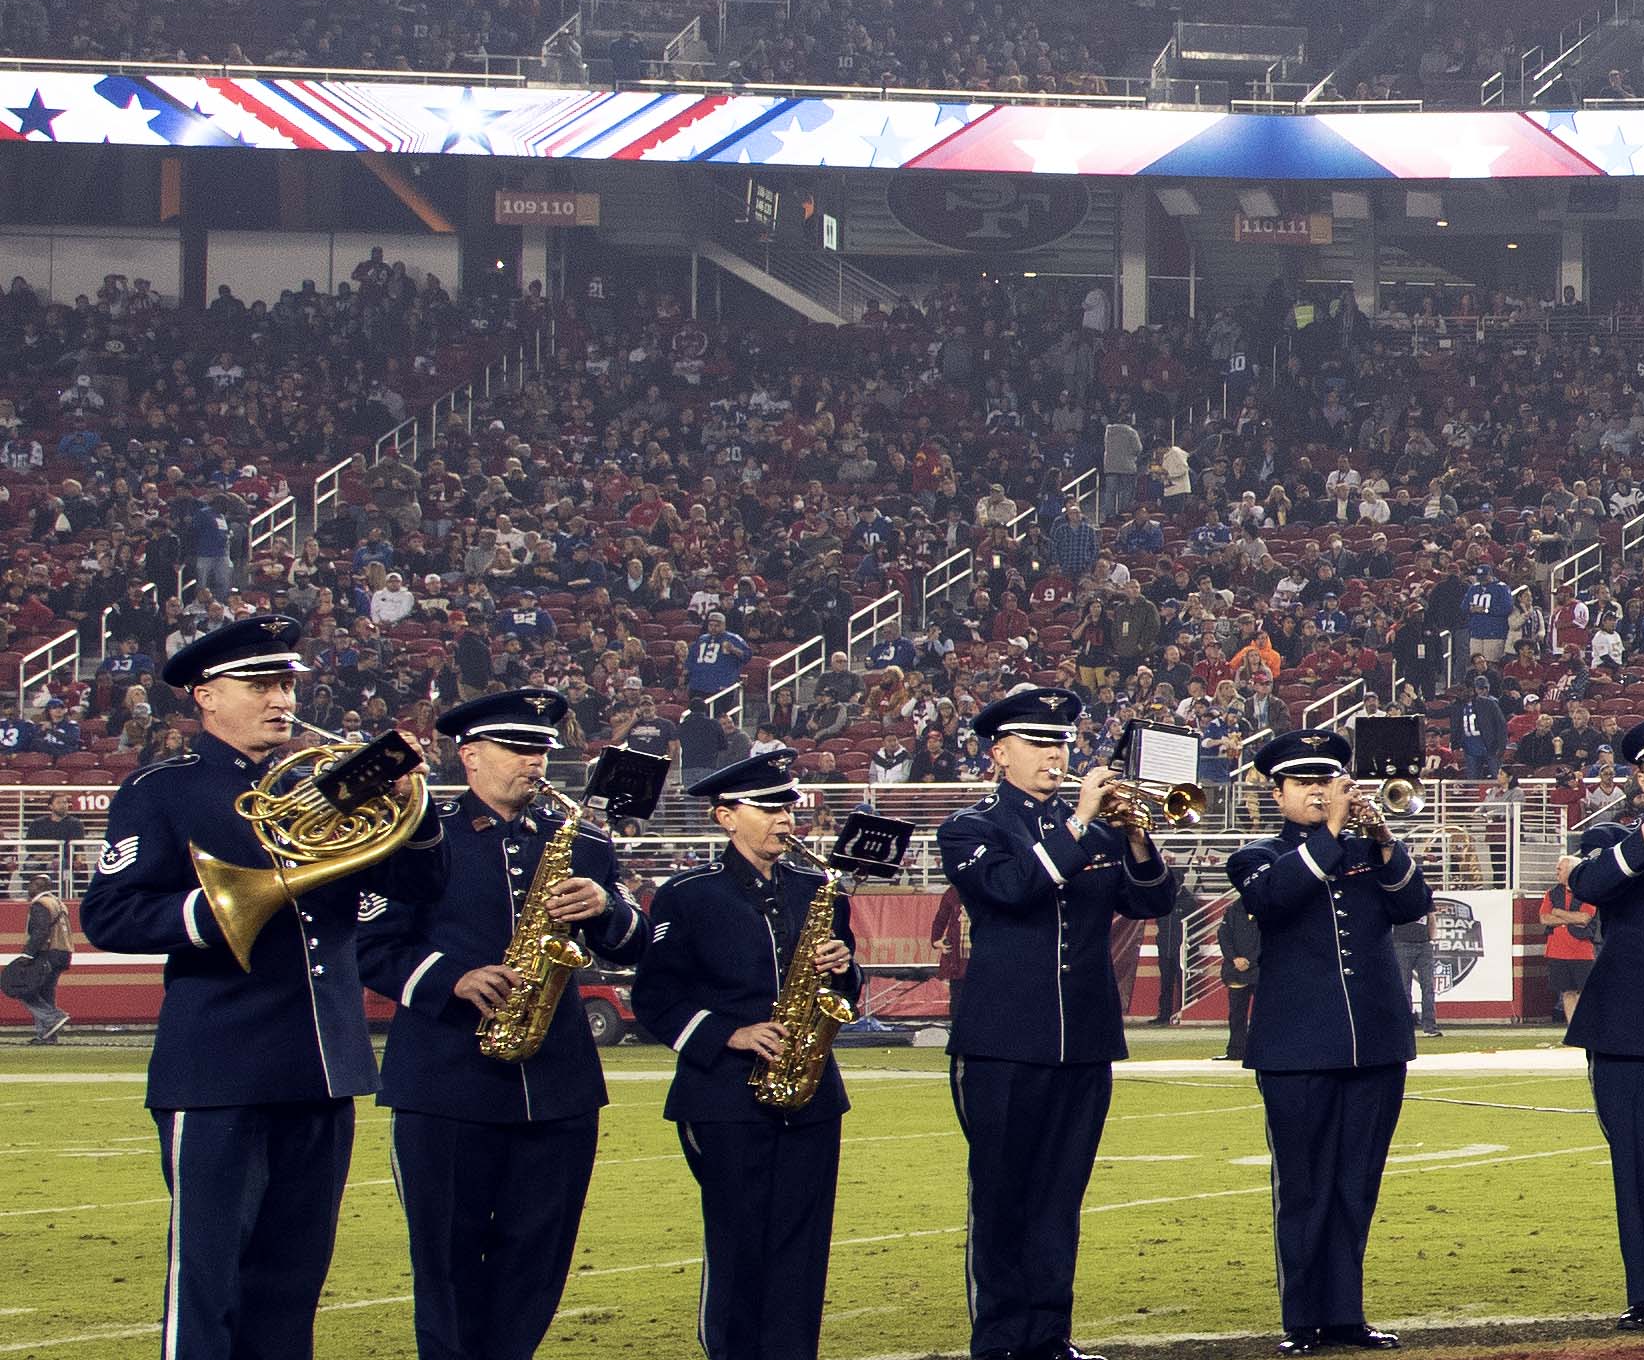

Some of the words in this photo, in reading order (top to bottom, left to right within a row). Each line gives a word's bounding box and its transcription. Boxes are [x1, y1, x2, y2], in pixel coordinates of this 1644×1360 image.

[414, 25, 428, 37] 13
[838, 57, 853, 68] 10
[503, 200, 535, 215] 109
[540, 200, 574, 215] 110
[1277, 220, 1308, 235] 111
[589, 282, 605, 299] 21
[1230, 356, 1246, 372] 10
[863, 532, 880, 548] 10
[1471, 594, 1492, 611] 10
[697, 642, 721, 663] 13
[78, 794, 110, 810] 110
